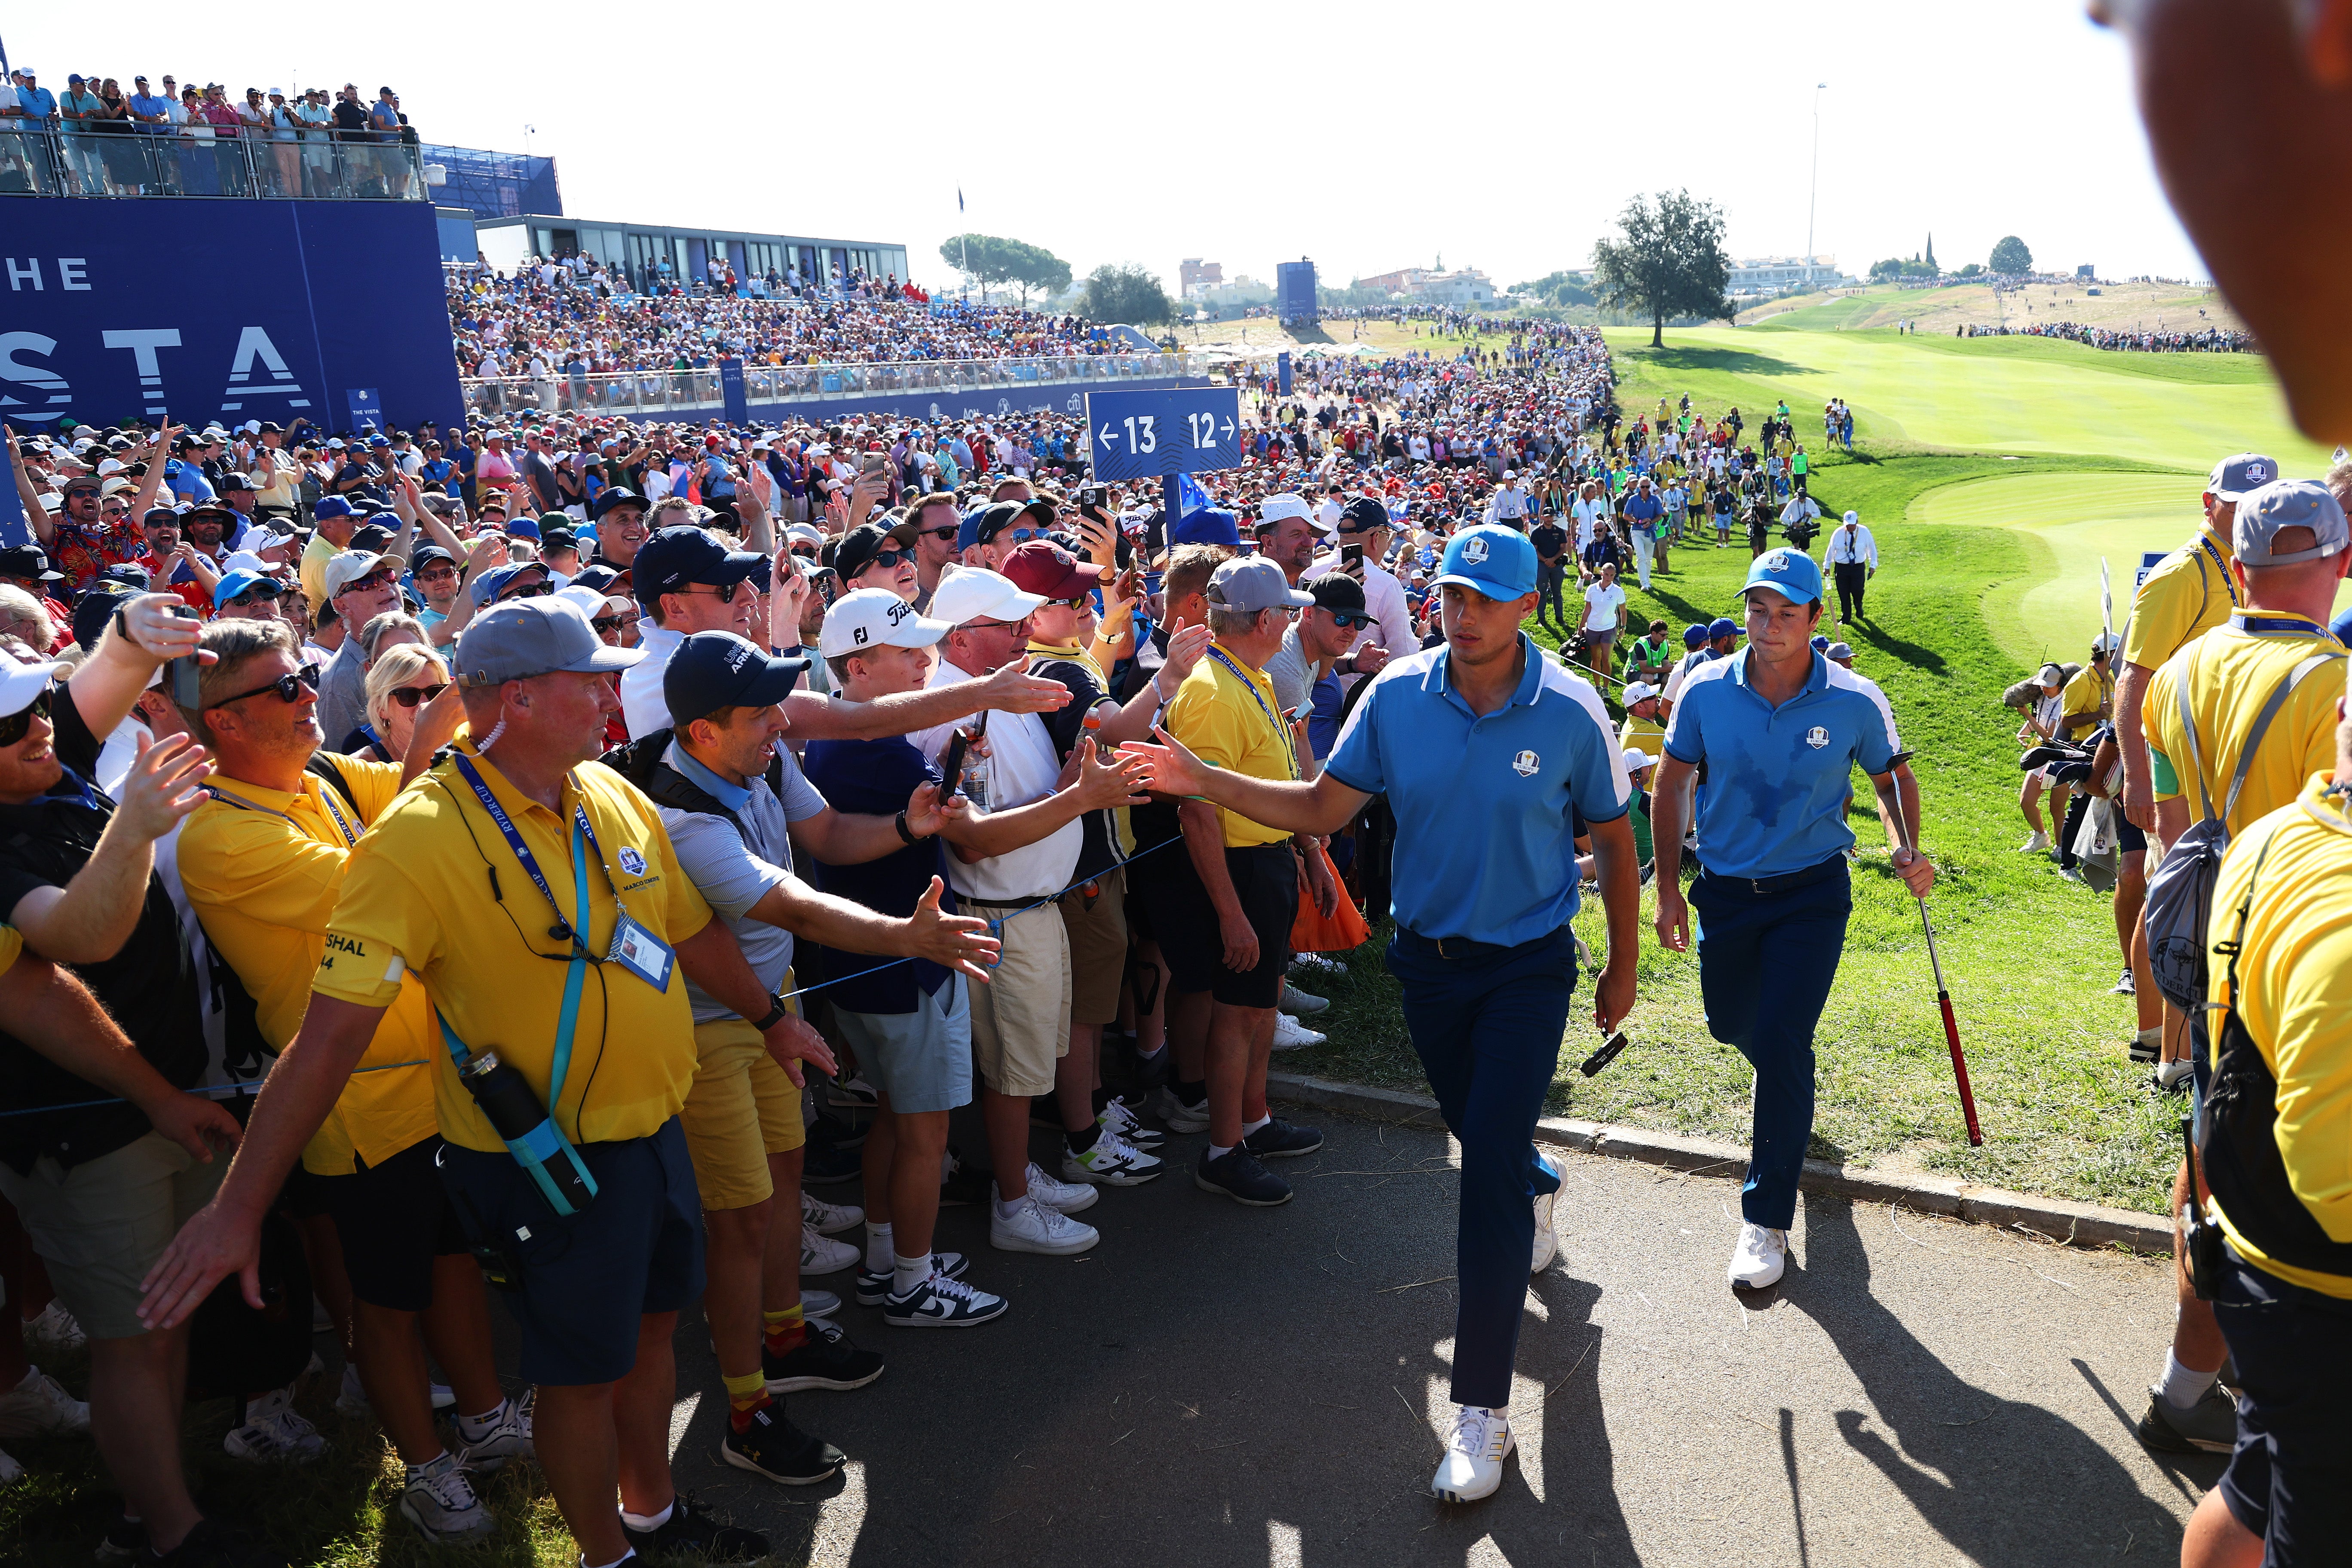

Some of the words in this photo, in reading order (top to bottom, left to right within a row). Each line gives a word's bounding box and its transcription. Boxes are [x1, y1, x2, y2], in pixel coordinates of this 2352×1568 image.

[1067, 394, 1080, 411] citi
[1124, 416, 1156, 454] 13
[1188, 412, 1216, 449] 12
[2207, 545, 2220, 565] RYDER
[2219, 563, 2227, 575] CUP
[853, 626, 868, 645] FJ
[1218, 654, 1231, 665] CUP
[1229, 663, 1246, 681] RYDER
[1262, 703, 1271, 717] CUP
[1268, 715, 1282, 735] RYDER
[475, 785, 493, 803] CUP
[331, 806, 343, 824] CUP
[487, 802, 514, 833] RYDER
[579, 818, 593, 839] CUP
[532, 873, 548, 894] CUP
[623, 880, 644, 891] MARCO
[643, 876, 660, 884] SIMONE
[325, 933, 365, 957] SHAL
[2153, 967, 2184, 994] RYDER
[2168, 992, 2186, 1005] 2023
[1971, 1120, 1981, 1140] WINN
